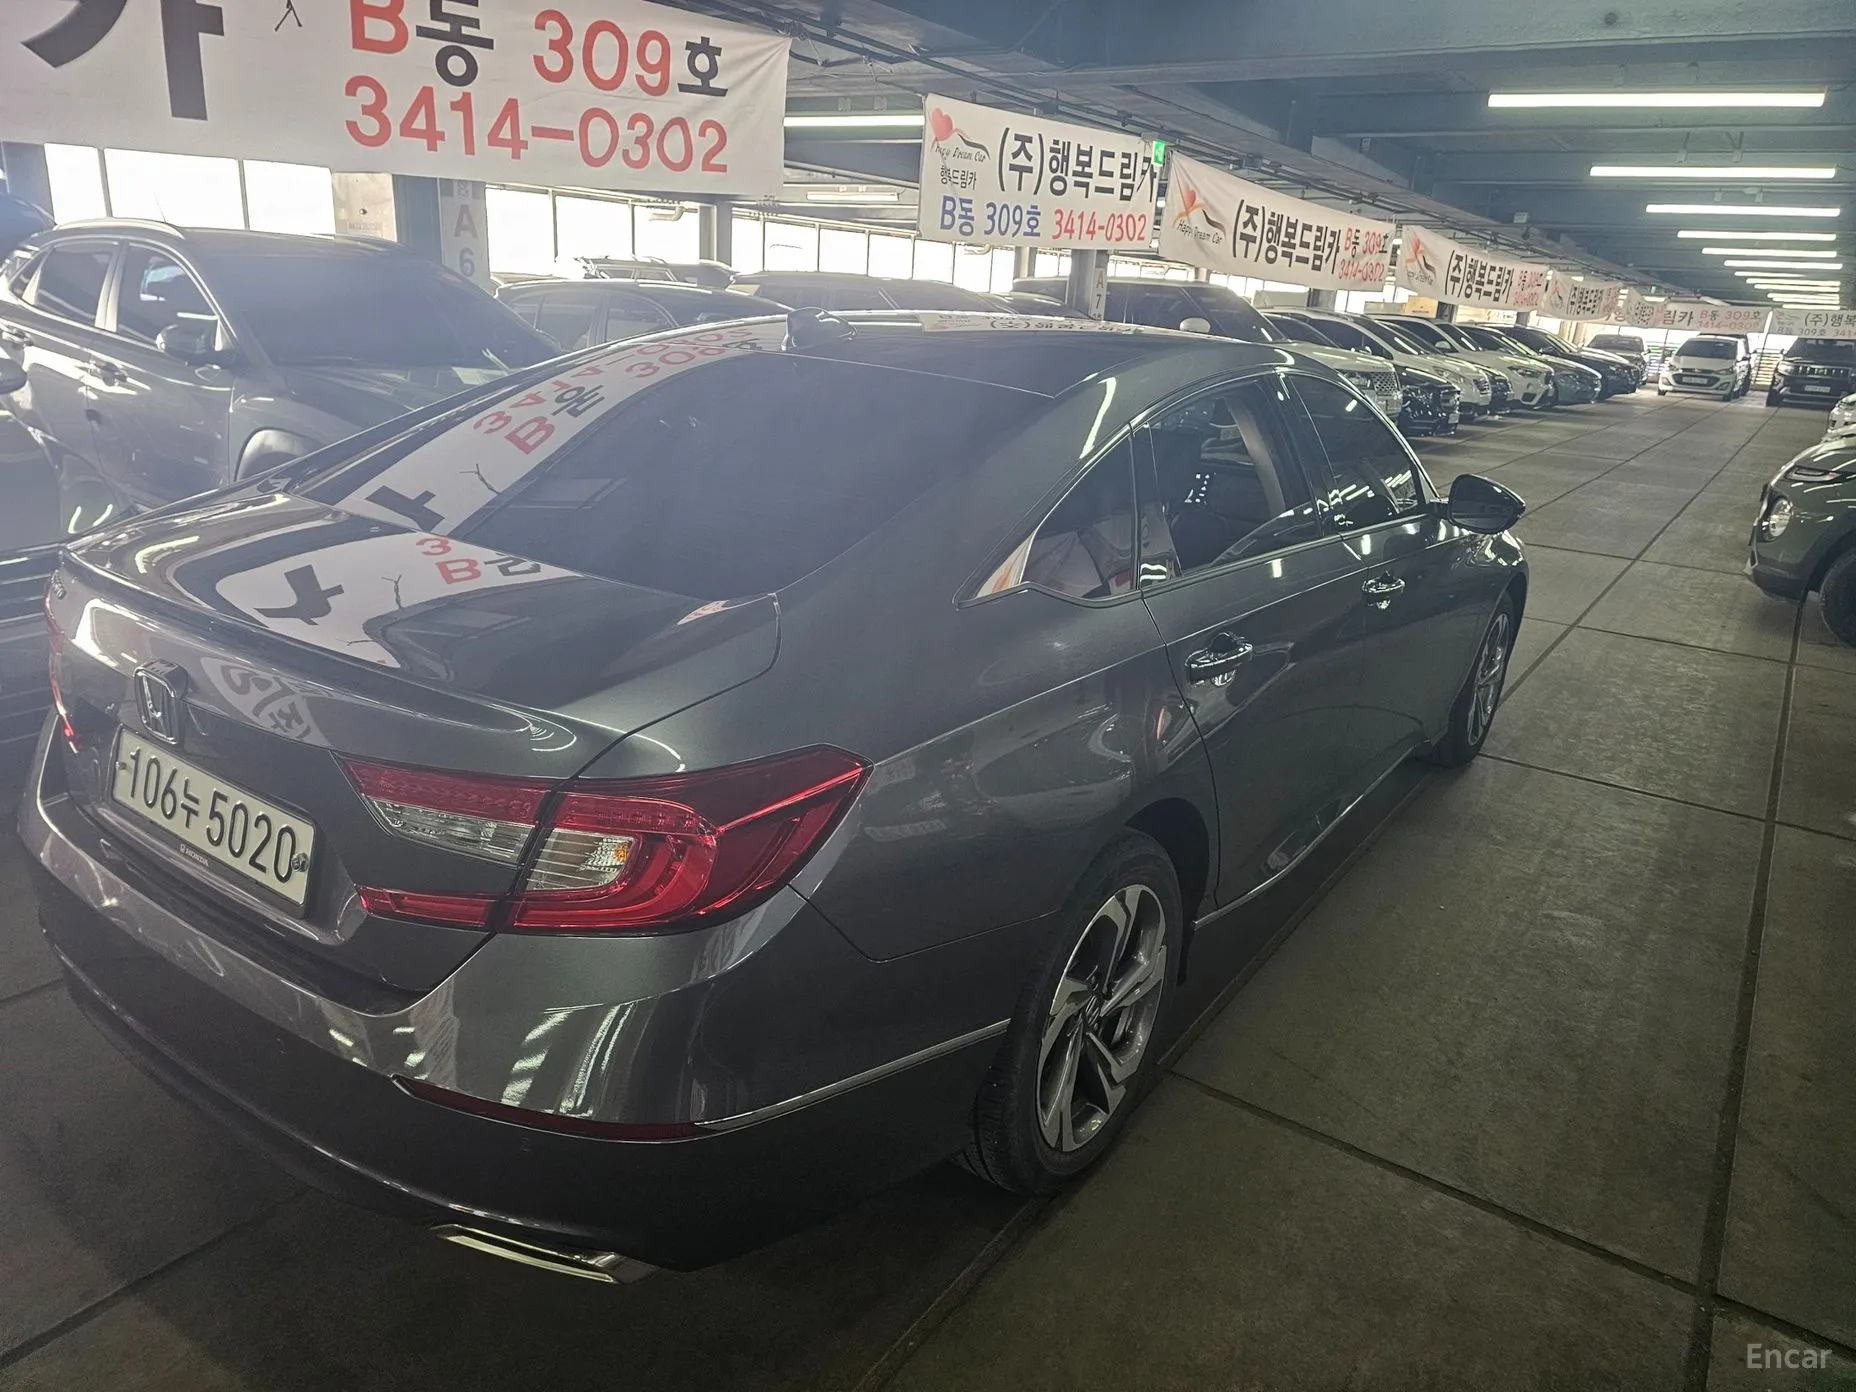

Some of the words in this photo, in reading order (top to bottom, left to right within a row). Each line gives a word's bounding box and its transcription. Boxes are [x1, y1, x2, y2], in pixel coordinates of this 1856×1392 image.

[350, 0, 495, 87] B동
[532, 10, 728, 97] 309호
[344, 75, 728, 173] 3414-0302
[997, 127, 1157, 203] (주)행복드림카
[454, 203, 477, 238] A
[939, 194, 975, 237] B동
[983, 202, 1042, 239] 309호
[1051, 208, 1148, 242] 3414-0302
[1231, 198, 1342, 275] (주)행복드림카
[1343, 227, 1361, 258] B동
[1362, 231, 1389, 255] 309호
[459, 248, 475, 277] 6
[1444, 249, 1515, 304] (주)행복드림카
[129, 745, 297, 885] 106누5020
